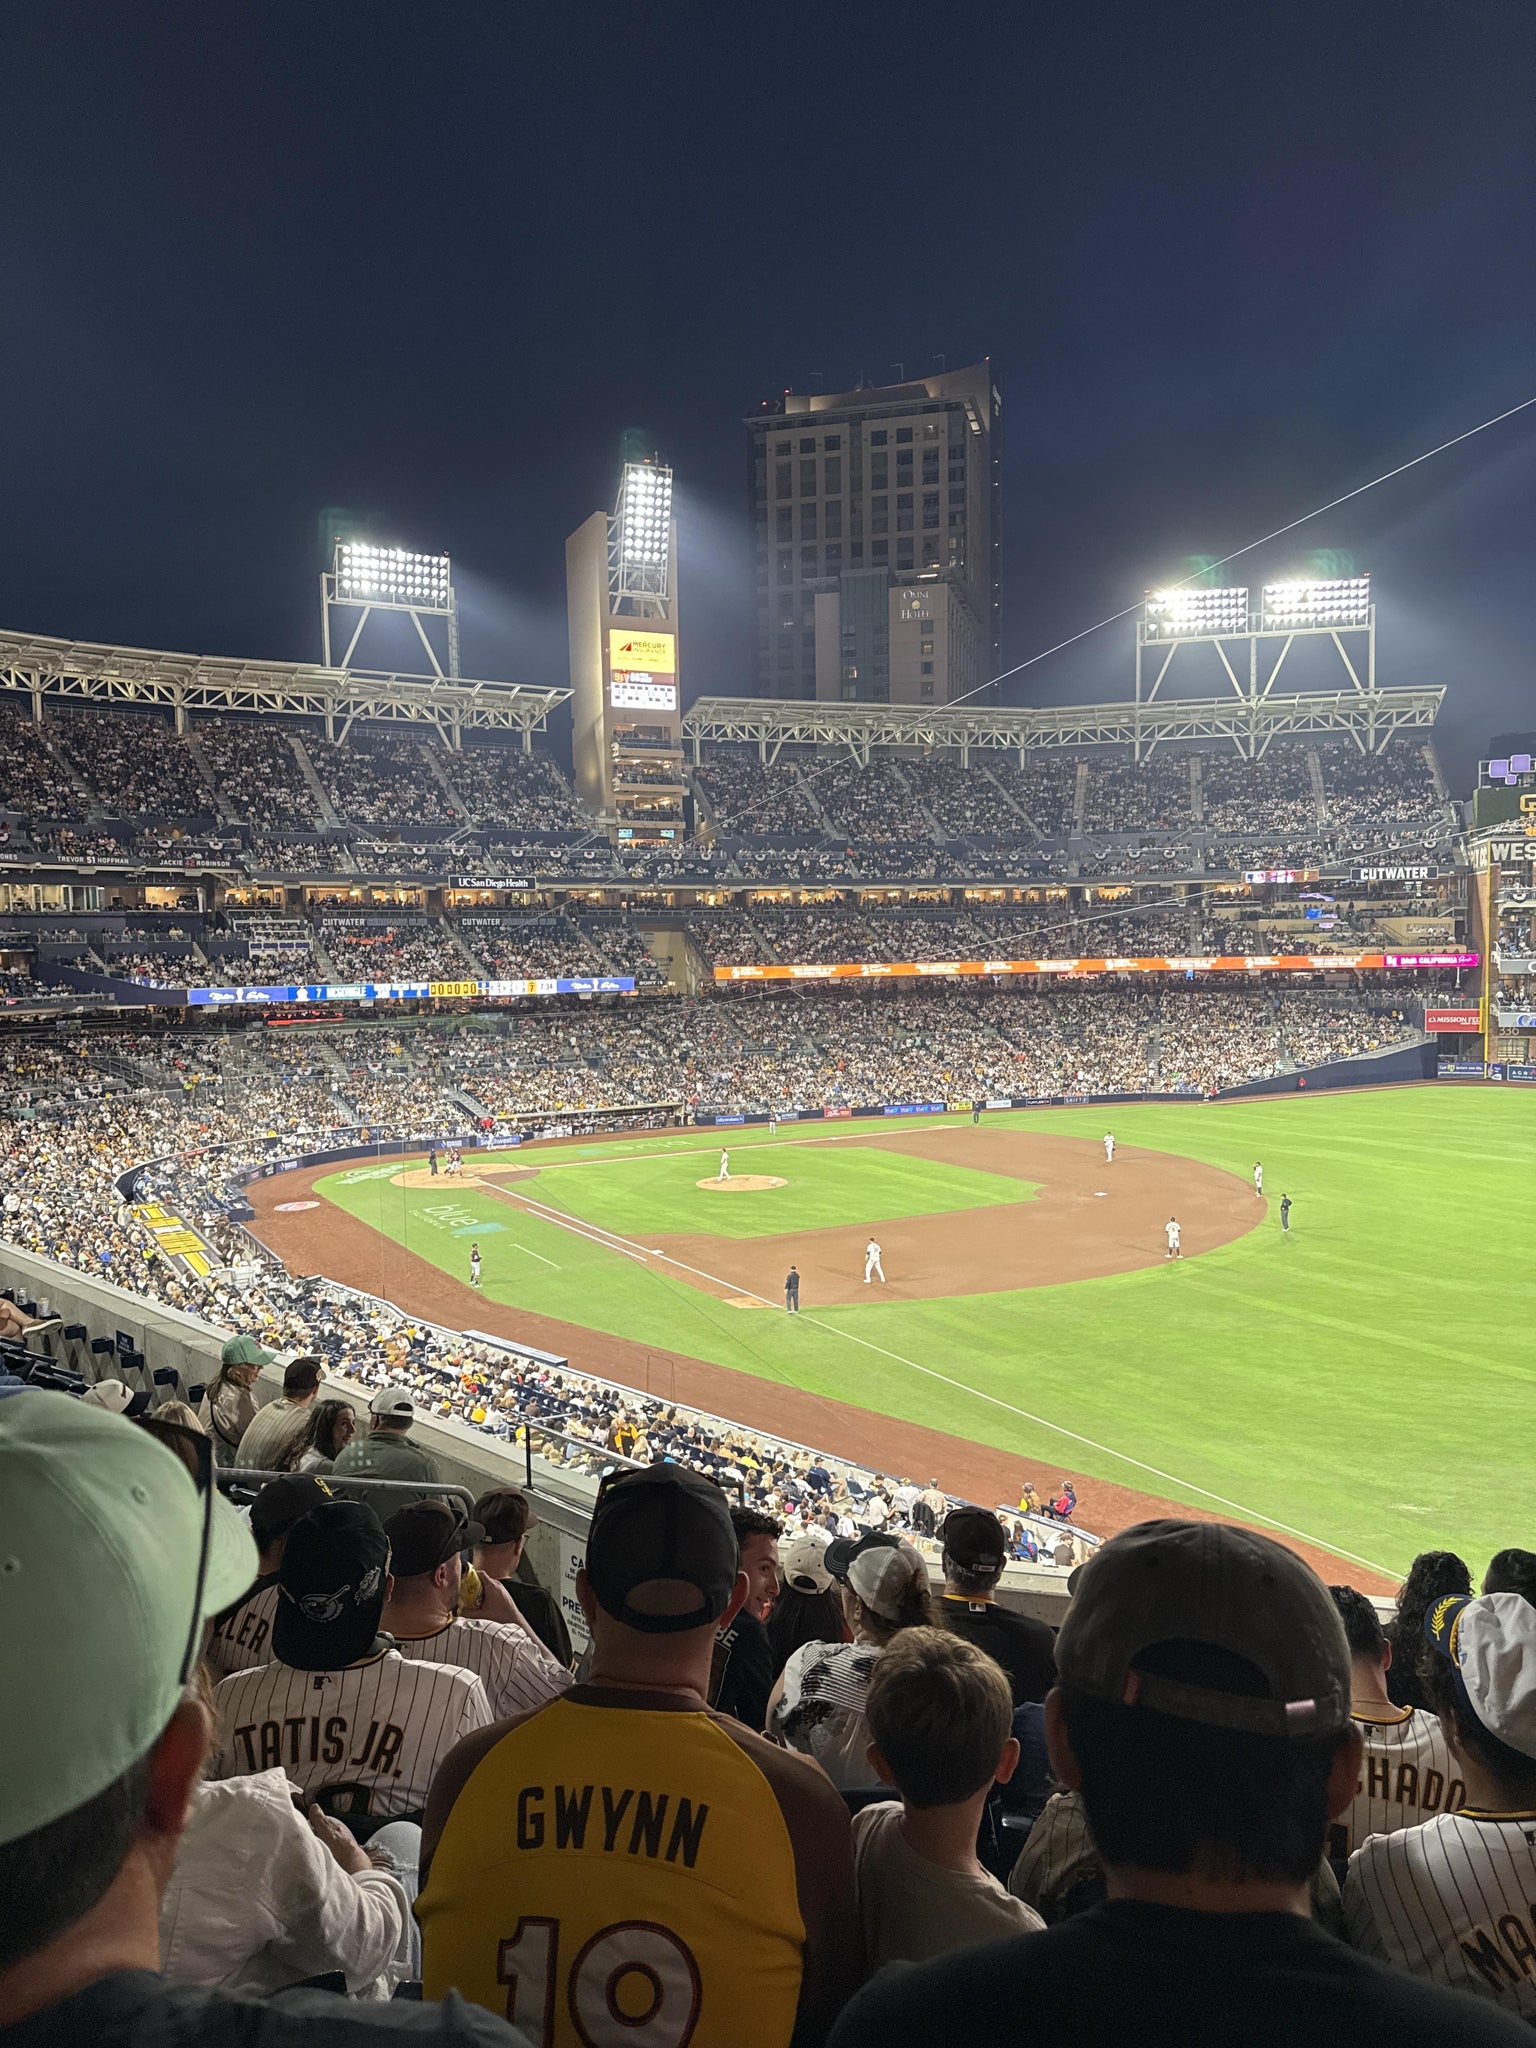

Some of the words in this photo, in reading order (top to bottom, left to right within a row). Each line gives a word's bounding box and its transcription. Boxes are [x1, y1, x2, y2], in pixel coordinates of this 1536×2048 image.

[633, 641, 666, 649] MERCURY
[1491, 843, 1536, 861] WES
[87, 856, 96, 864] 51
[1360, 867, 1429, 880] CUTWATER
[458, 878, 471, 887] UC
[471, 878, 485, 887] San
[485, 878, 505, 889] Diego
[506, 878, 529, 888] Health
[322, 918, 365, 926] CUTWATER
[462, 918, 501, 926] CUTWATER
[1418, 956, 1458, 964] CALIFORNIA
[422, 1203, 479, 1227] blue
[235, 1716, 347, 1771] TATIS
[351, 1720, 404, 1778] JR.
[1357, 1756, 1467, 1813] HADO
[516, 1785, 710, 1869] GWYNN
